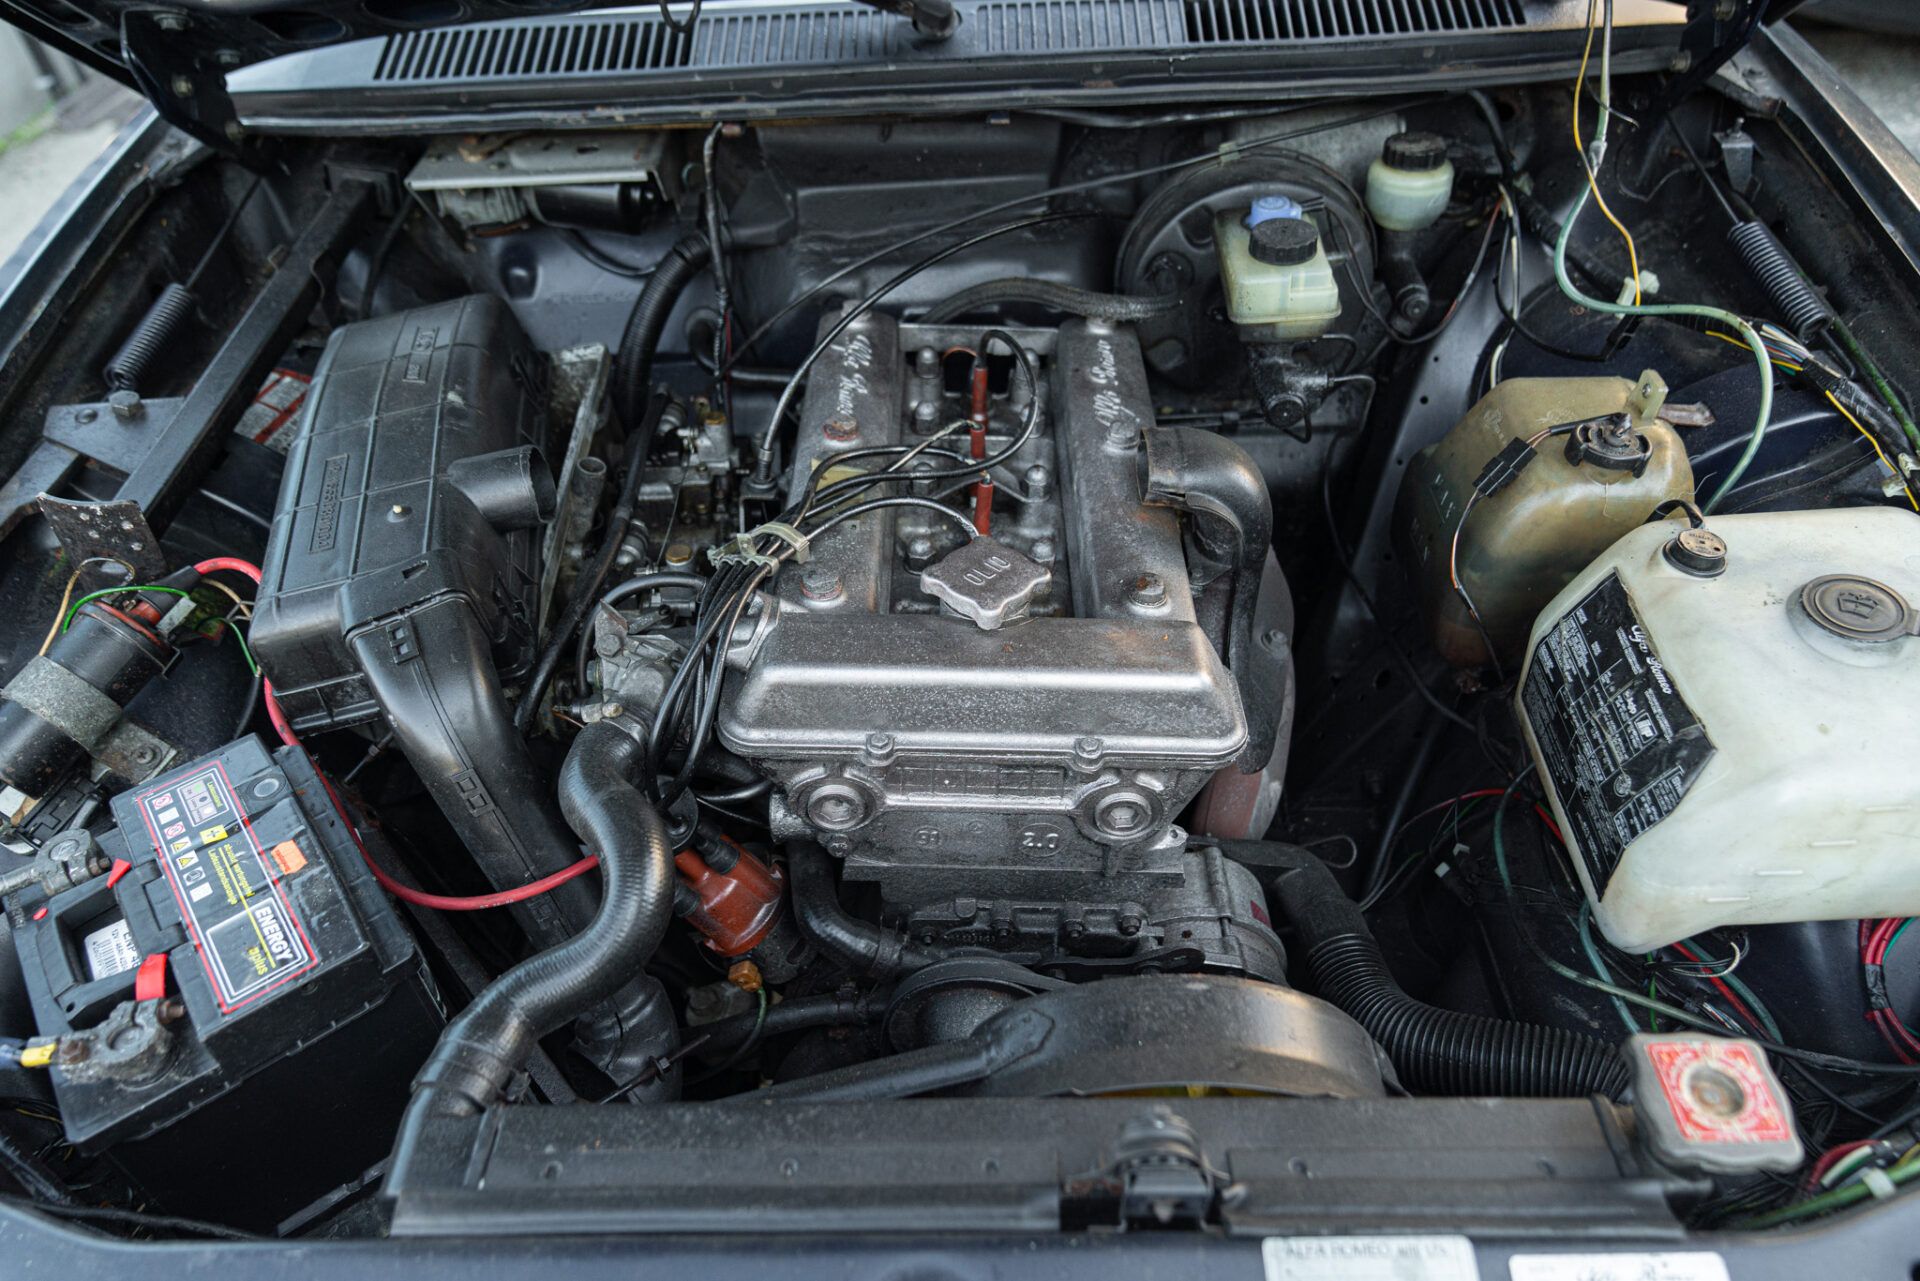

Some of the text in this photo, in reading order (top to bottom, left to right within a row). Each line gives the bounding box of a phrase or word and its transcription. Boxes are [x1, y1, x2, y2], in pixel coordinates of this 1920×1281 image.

[963, 556, 1010, 585] OLIO
[1628, 624, 1648, 653] Alfa
[1646, 656, 1672, 694] Romeo
[1021, 831, 1060, 849] 2.0
[255, 906, 293, 961] ENERGY
[247, 946, 268, 975] aplus
